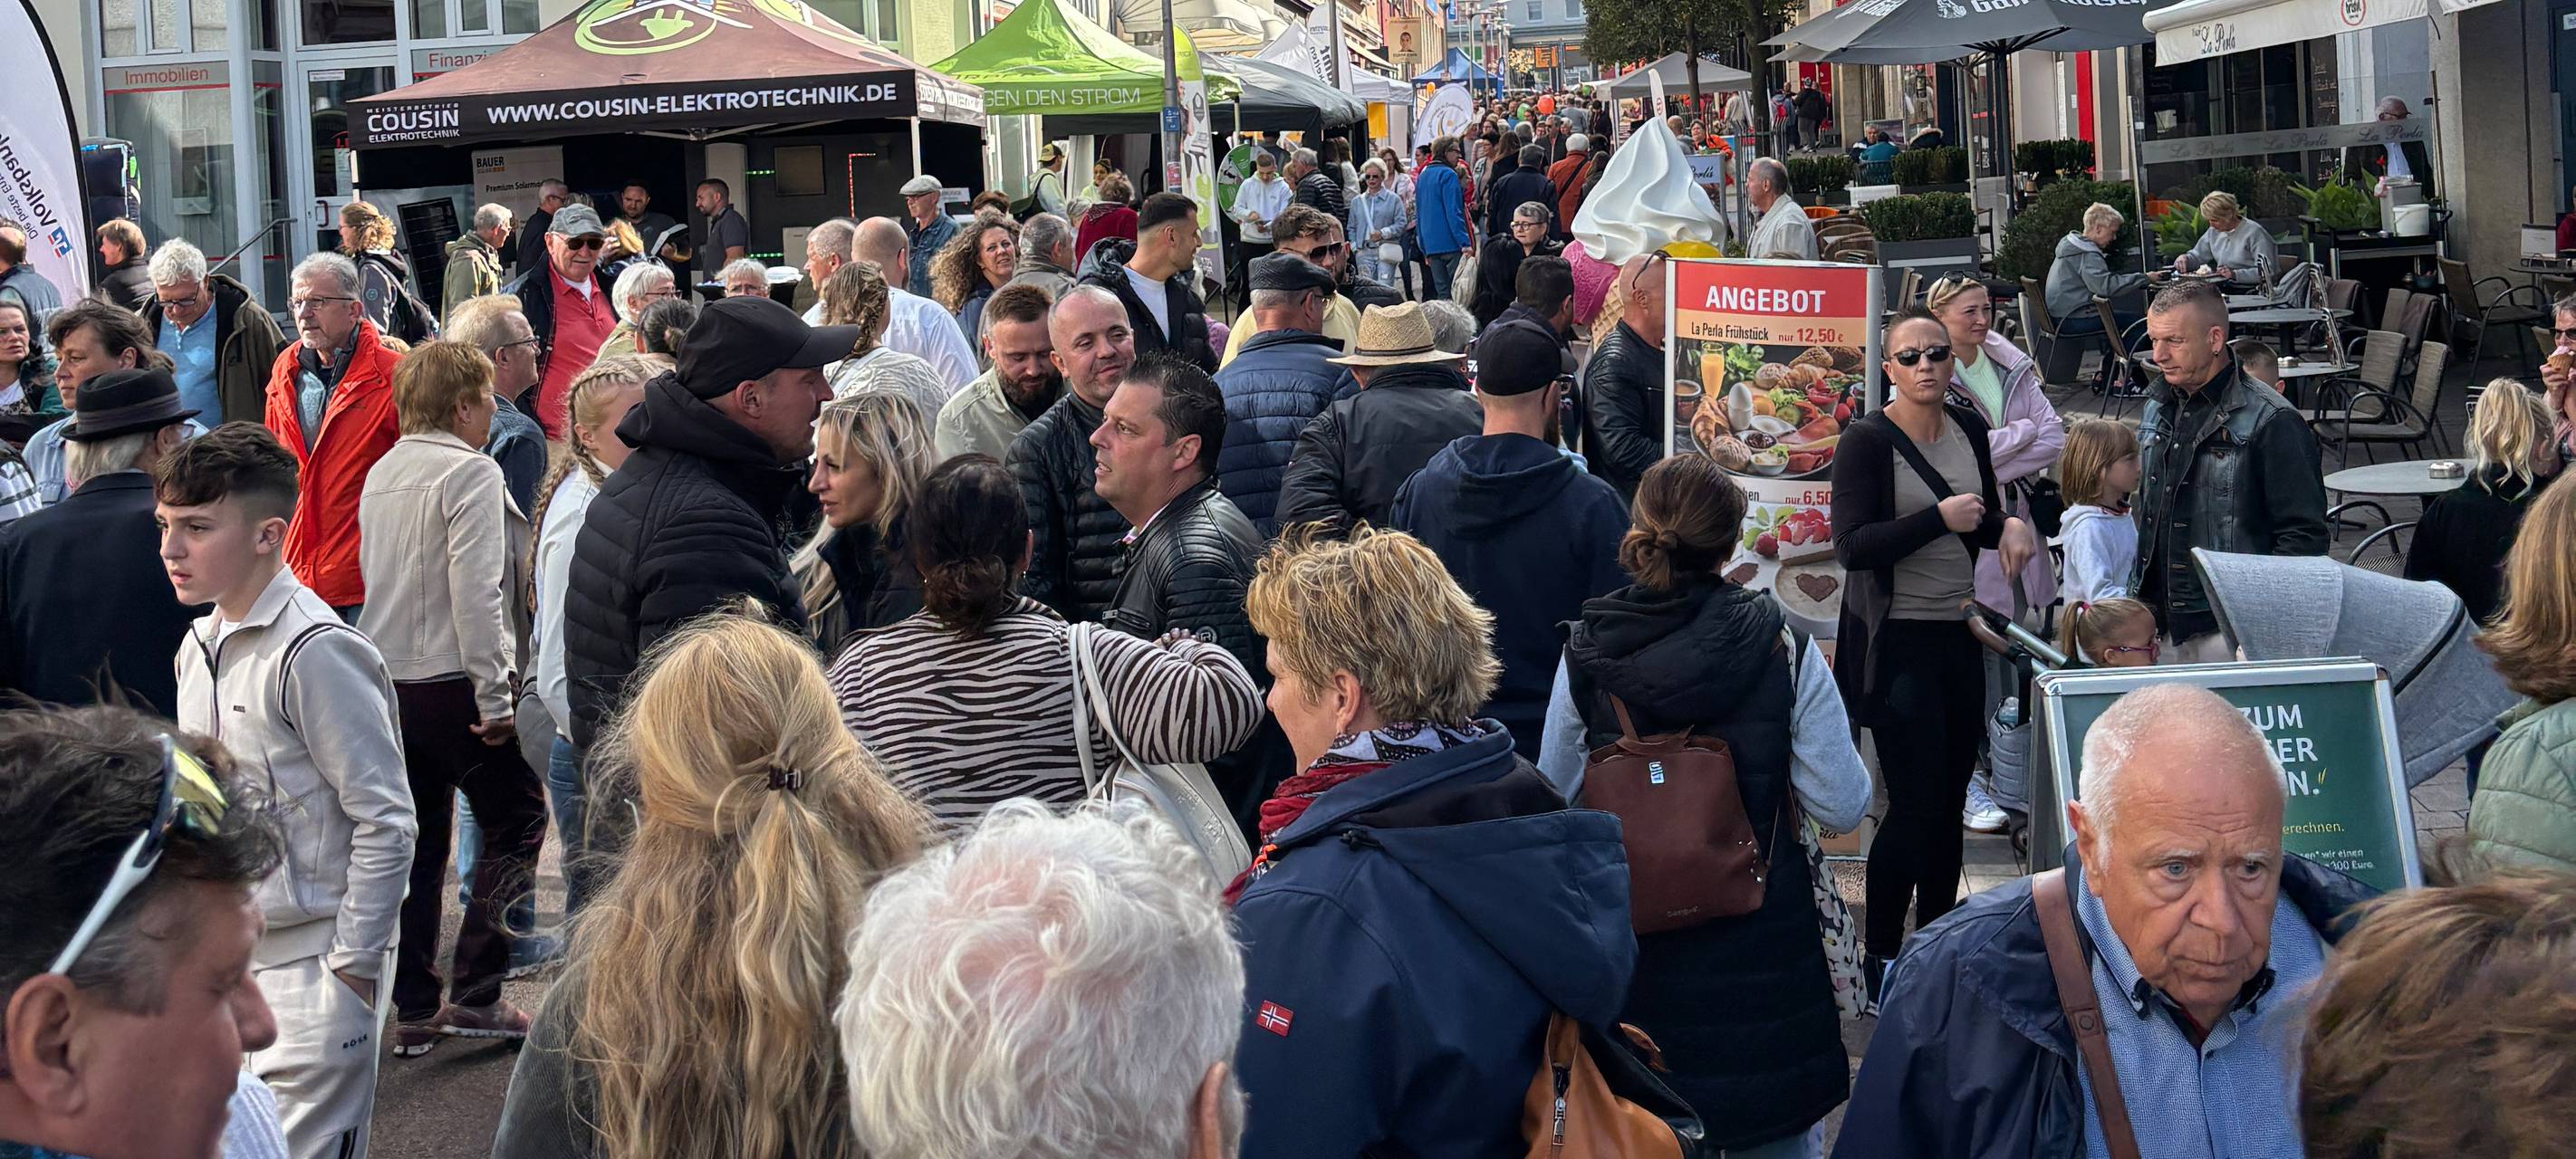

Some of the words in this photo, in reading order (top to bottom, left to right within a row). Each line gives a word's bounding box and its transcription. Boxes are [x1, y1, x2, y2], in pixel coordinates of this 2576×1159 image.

[125, 66, 210, 85] Immobilien
[486, 82, 897, 125] WWW.COUSIN-ELEKTROTECHNIK.DE
[1025, 90, 1066, 106] DEN
[1071, 87, 1141, 105] STROM
[366, 102, 459, 113] MEISTERBETRIEB
[368, 110, 459, 132] COUSIN
[369, 129, 460, 143] ELEKTROTECHNIK
[476, 156, 505, 168] BAUER
[485, 184, 514, 193] Premium
[1705, 285, 1826, 313] ANGEBOT
[1691, 321, 1700, 335] La
[1702, 322, 1723, 338] Perla
[1725, 324, 1769, 341] Frühstück
[1778, 333, 1793, 341] nur
[1797, 328, 1835, 344] 12,50
[1838, 333, 1844, 342] €
[1784, 496, 1802, 504] nur
[2321, 849, 2335, 858] wir
[2338, 848, 2364, 857] einen
